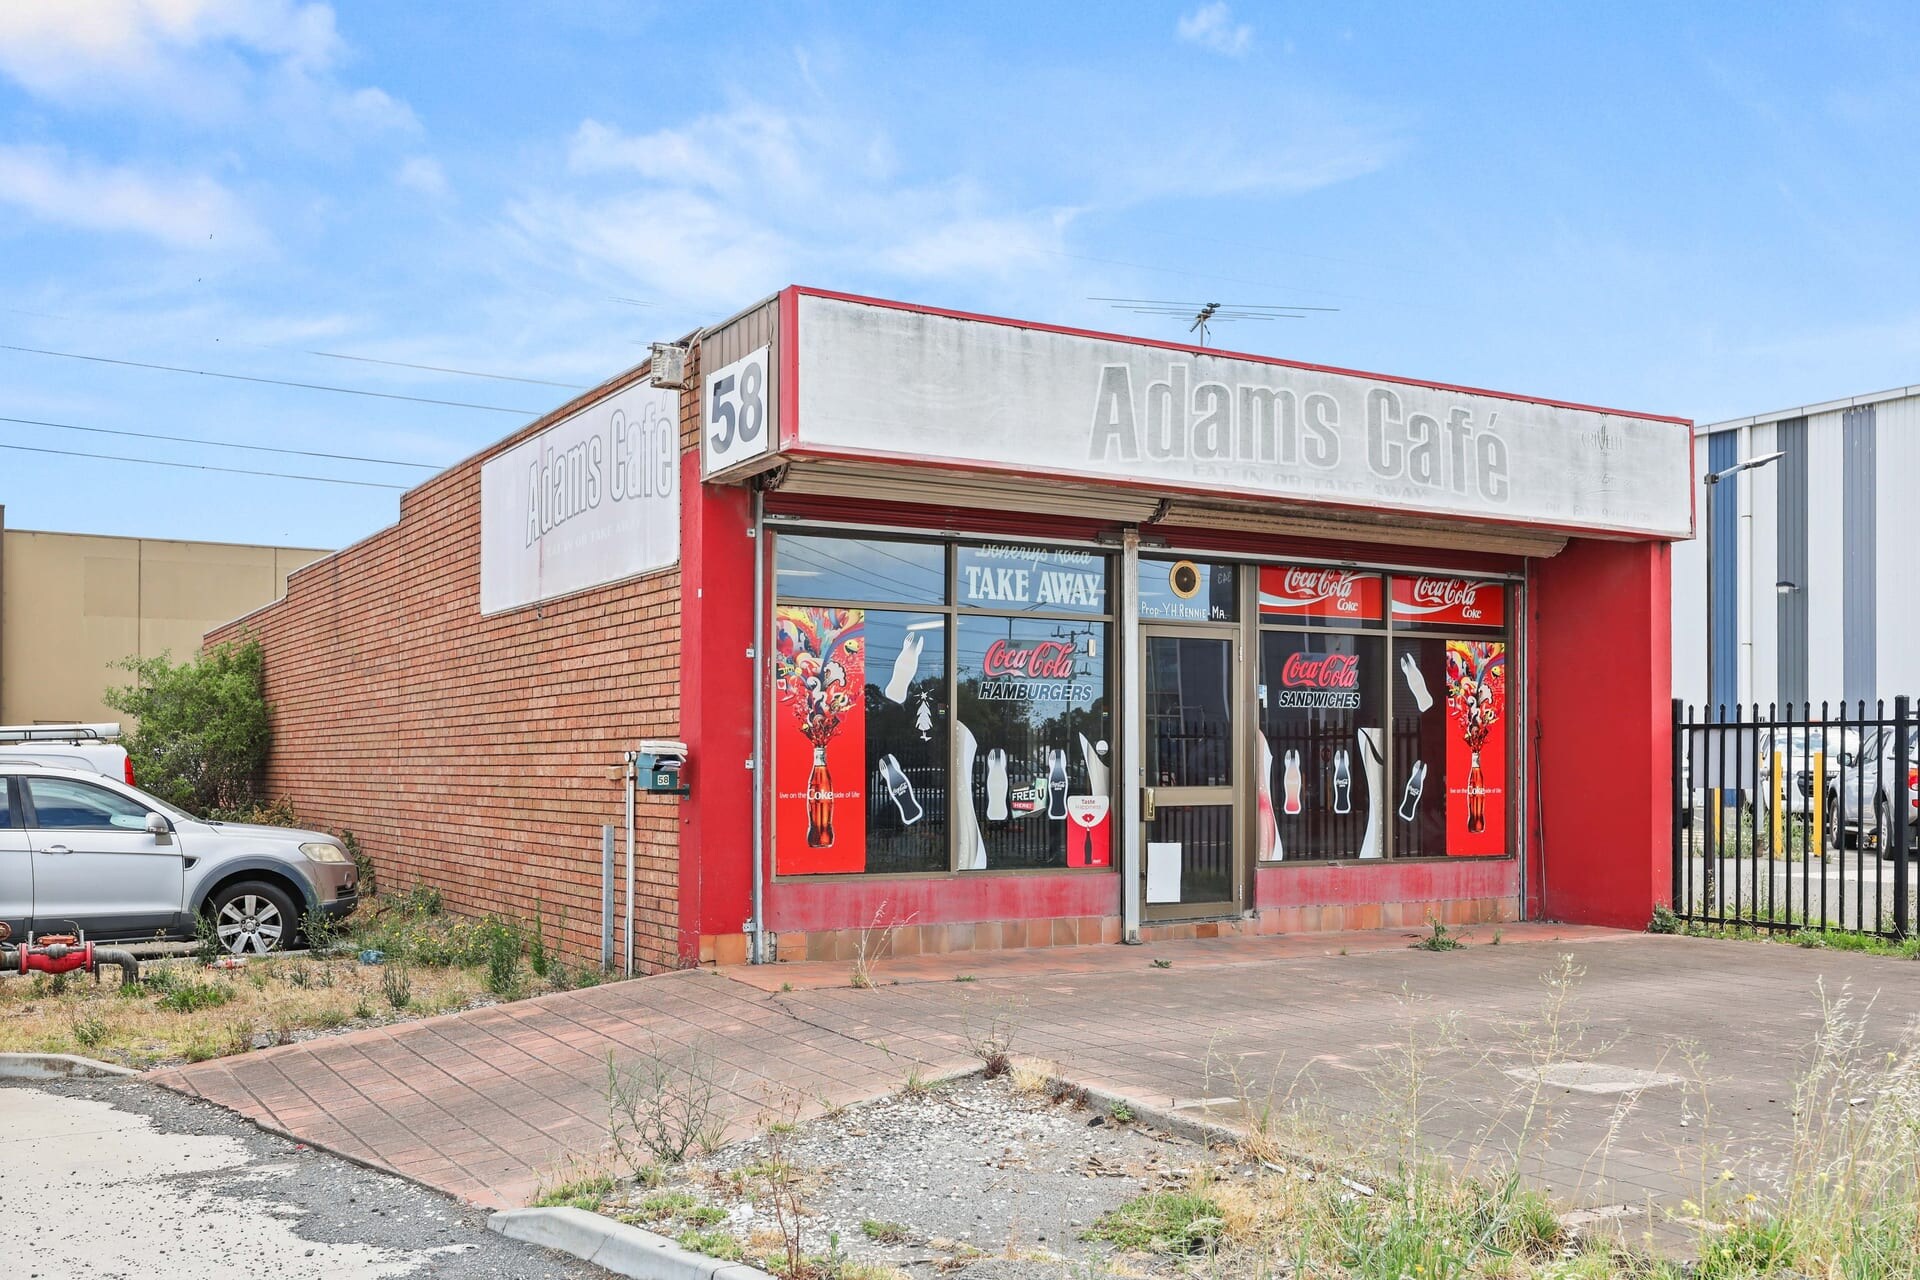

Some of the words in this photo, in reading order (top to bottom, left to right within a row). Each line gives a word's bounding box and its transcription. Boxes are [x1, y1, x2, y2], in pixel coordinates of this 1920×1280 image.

[710, 362, 764, 455] 58
[1088, 363, 1341, 470] Adams
[1365, 387, 1512, 505] Café
[526, 434, 602, 549] Adams
[609, 389, 673, 501] Café
[965, 566, 1029, 602] TAKE
[1036, 571, 1101, 606] AWAY
[1337, 598, 1359, 611] Coke
[1462, 606, 1482, 619] Coke
[983, 639, 1078, 679] Coca-Cola
[1282, 652, 1359, 688] Coca-Cola
[978, 681, 1093, 702] HAMBURGERS
[1280, 691, 1360, 709] SANDWICHES
[658, 776, 669, 784] 58
[808, 788, 833, 800] Coke
[1011, 789, 1036, 801] FREE
[1467, 785, 1485, 795] Coke
